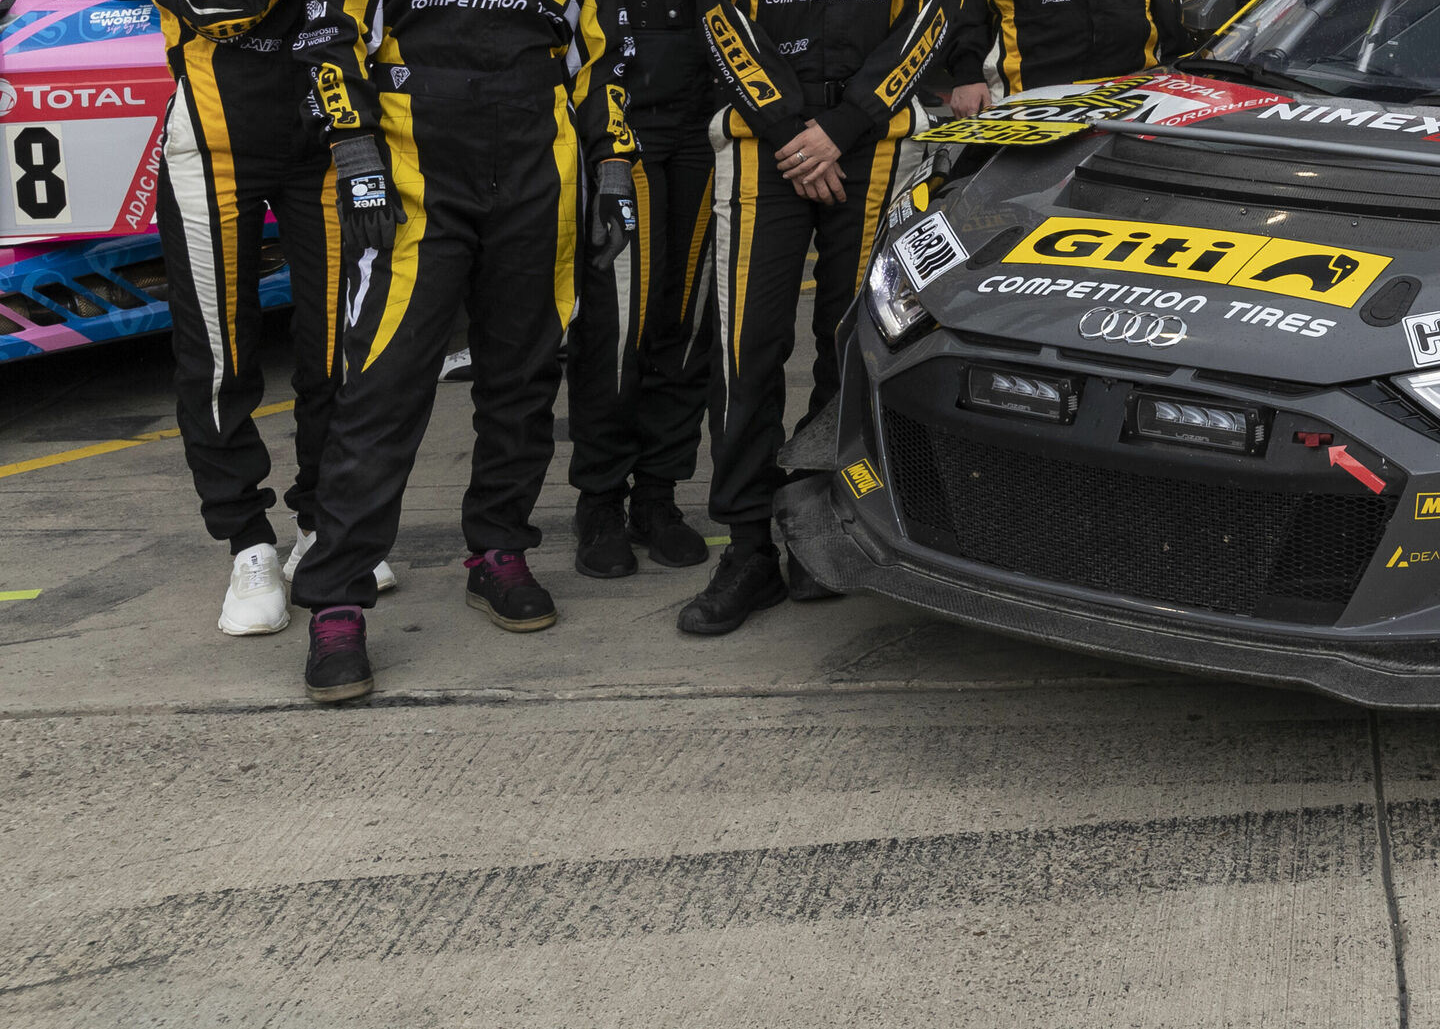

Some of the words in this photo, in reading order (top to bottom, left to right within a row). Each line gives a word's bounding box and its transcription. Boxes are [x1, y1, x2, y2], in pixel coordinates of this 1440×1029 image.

[90, 6, 151, 20] CHANGE
[100, 16, 150, 27] WORLD
[24, 85, 145, 107] TOTAL
[14, 126, 67, 220] 8
[1033, 228, 1236, 273] Giti
[977, 274, 1208, 314] COMPETITION
[1223, 301, 1337, 338] TIRES
[847, 462, 874, 494] MOTUL
